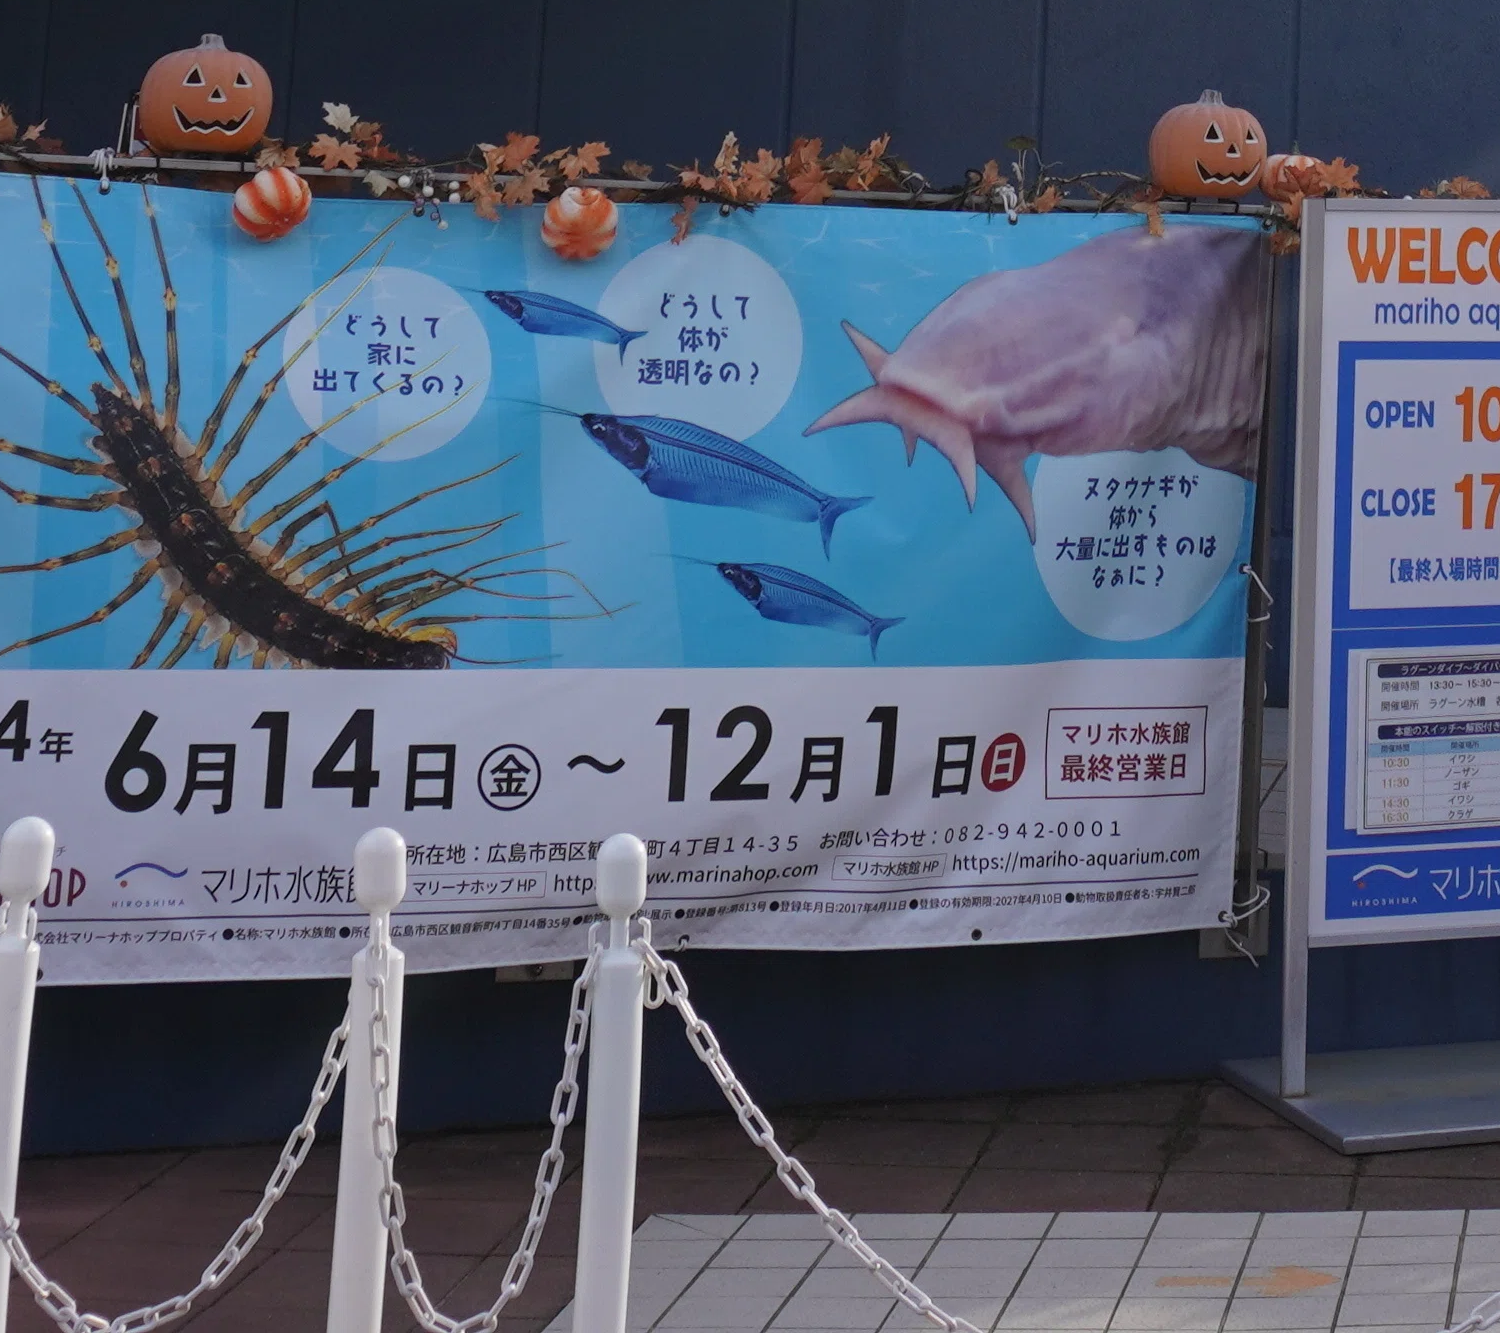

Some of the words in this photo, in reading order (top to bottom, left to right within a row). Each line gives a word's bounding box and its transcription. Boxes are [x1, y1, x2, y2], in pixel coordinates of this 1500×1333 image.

[660, 292, 750, 320] どうして
[1375, 298, 1460, 325] mariho
[346, 314, 441, 339] どうして
[678, 326, 729, 353] 体が
[367, 342, 416, 366] 家に
[1365, 400, 1435, 429] OPEN
[1084, 475, 1199, 501] ヌタウナギが
[1361, 488, 1436, 517] CLOSE
[1109, 505, 1157, 531] 体から
[1055, 533, 1217, 561] 大量に出すものは
[1060, 721, 1190, 748] マリホ水族館
[1060, 752, 1189, 783] 最終営業日
[951, 845, 1201, 874] https://mariho-aquarium.com
[112, 898, 186, 908] HIROSHIMA
